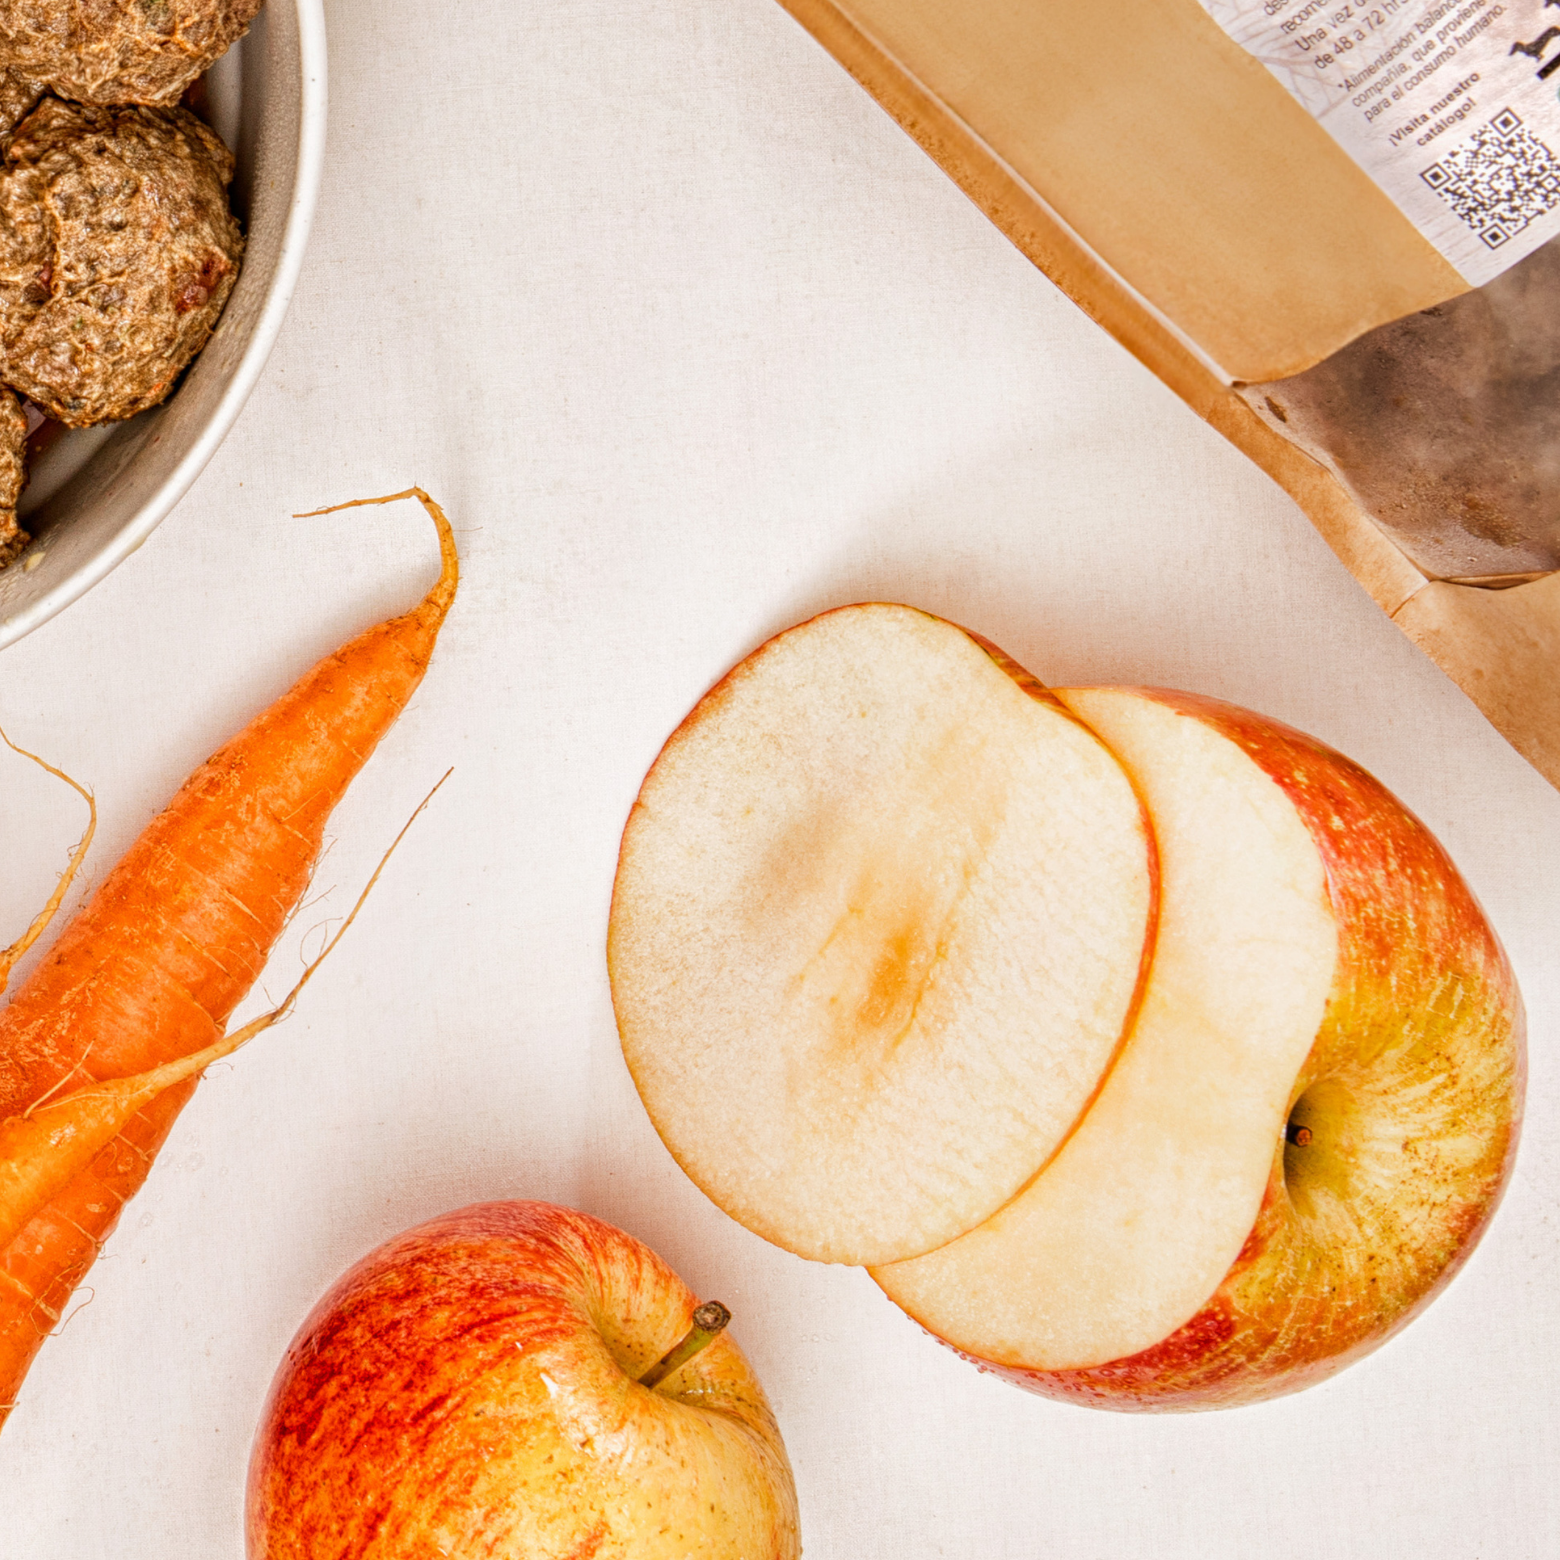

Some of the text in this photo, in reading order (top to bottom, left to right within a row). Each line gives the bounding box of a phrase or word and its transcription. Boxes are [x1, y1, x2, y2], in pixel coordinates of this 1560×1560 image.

[1293, 27, 1328, 52] Una
[1329, 4, 1355, 29] vez
[1313, 52, 1336, 70] de
[1333, 35, 1355, 55] 48
[1353, 28, 1367, 42] a
[1361, 9, 1386, 31] 72
[1411, 39, 1437, 63] que
[1363, 97, 1393, 124] para
[1391, 85, 1405, 102] el
[1403, 45, 1458, 92] consumo
[1428, 71, 1482, 116] nuestro
